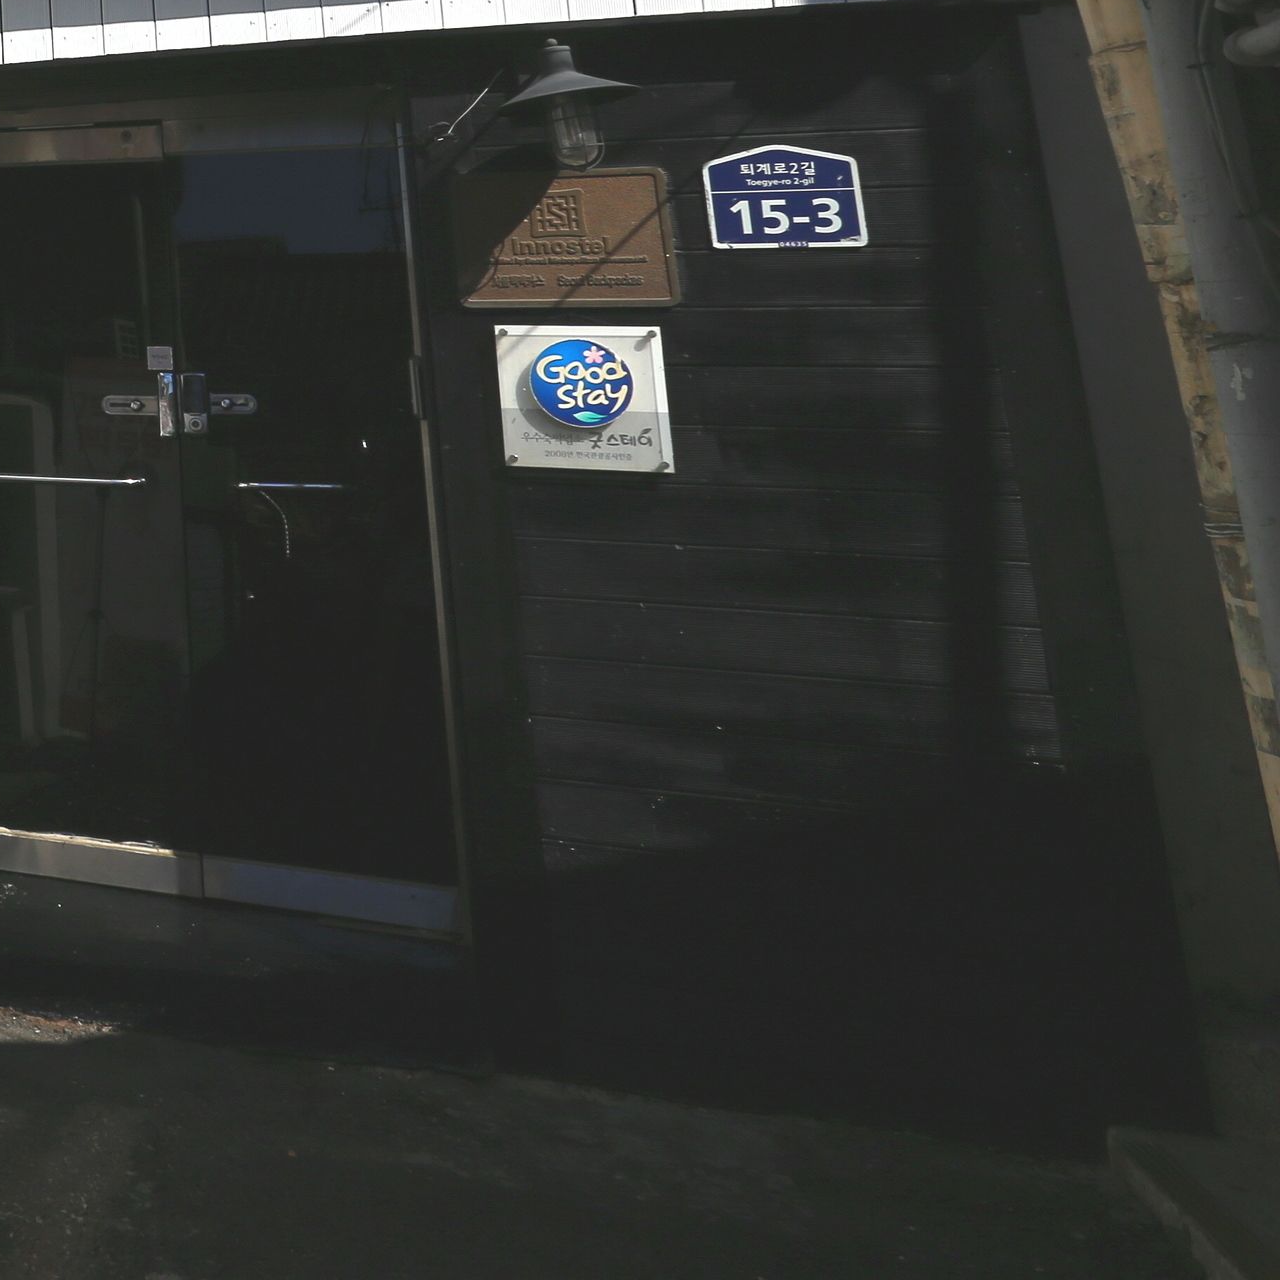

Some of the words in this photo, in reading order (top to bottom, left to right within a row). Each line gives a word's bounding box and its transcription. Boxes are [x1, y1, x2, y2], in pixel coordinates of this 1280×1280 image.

[740, 161, 816, 176] 퇴계로2길
[745, 178, 791, 187] Toegye-ro
[793, 177, 815, 186] 2-gil
[729, 197, 843, 235] 15-3
[511, 236, 609, 256] Innostel
[536, 354, 628, 384] Good
